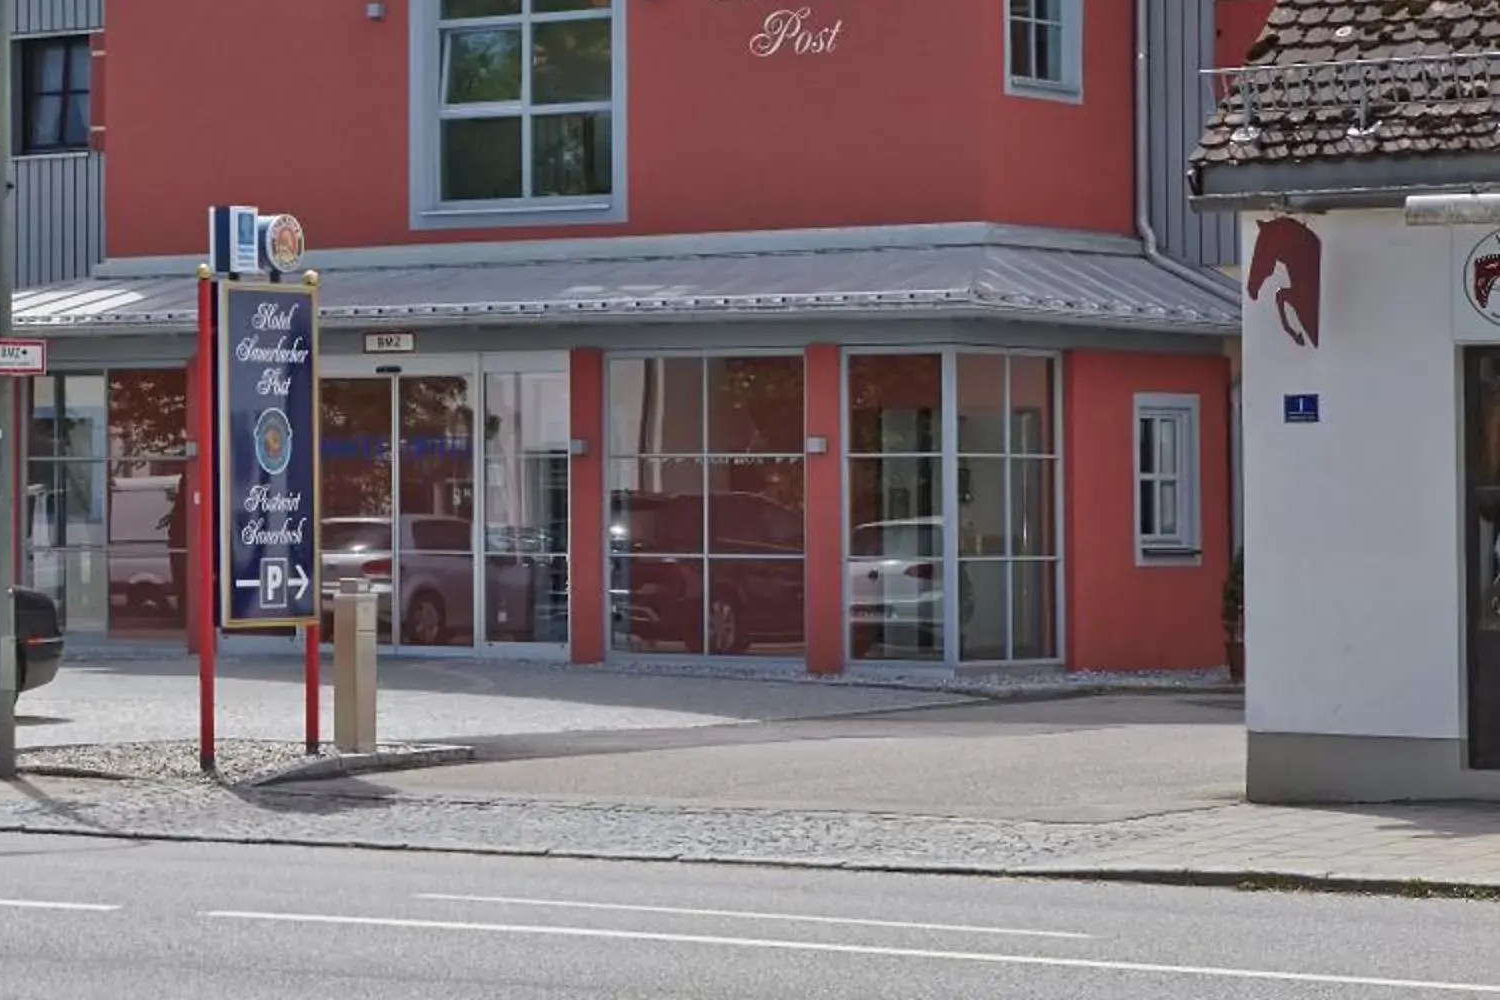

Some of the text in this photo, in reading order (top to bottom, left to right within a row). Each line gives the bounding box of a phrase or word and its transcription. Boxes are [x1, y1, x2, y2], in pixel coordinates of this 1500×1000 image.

[749, 6, 844, 57] Post
[252, 303, 298, 330] Hotel
[256, 368, 291, 396] Post
[267, 566, 283, 600] P
